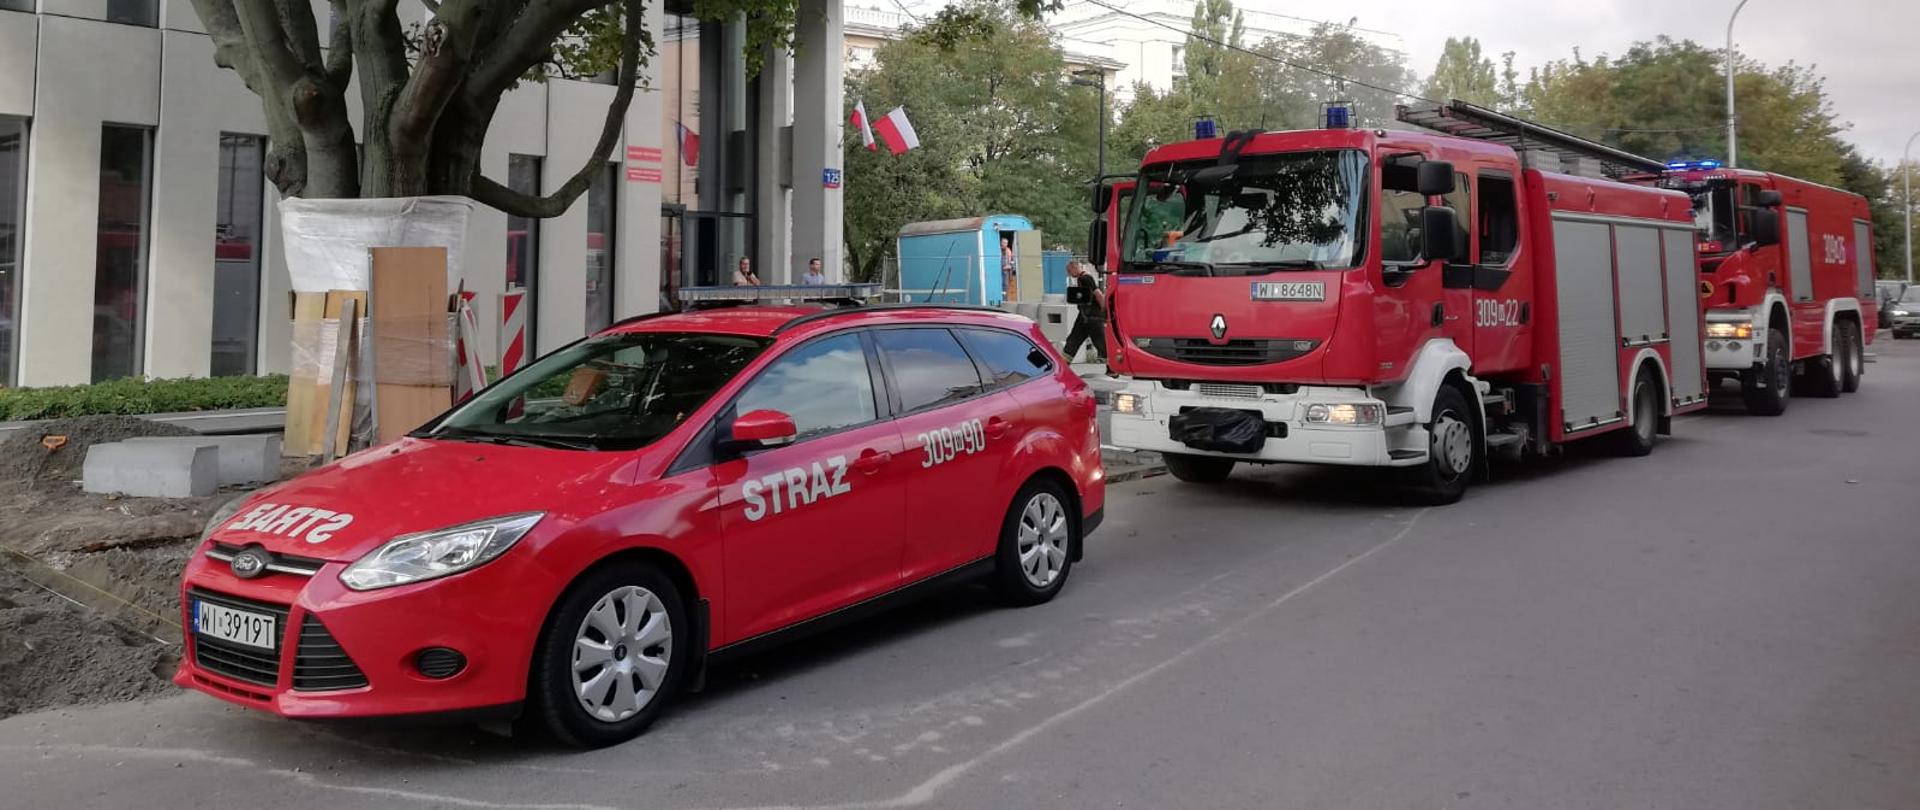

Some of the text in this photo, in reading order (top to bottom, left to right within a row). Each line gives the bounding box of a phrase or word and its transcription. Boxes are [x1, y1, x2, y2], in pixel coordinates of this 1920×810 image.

[1259, 283, 1322, 297] WI 8648N
[234, 554, 256, 571] Ford
[201, 604, 273, 647] WI 3919T
